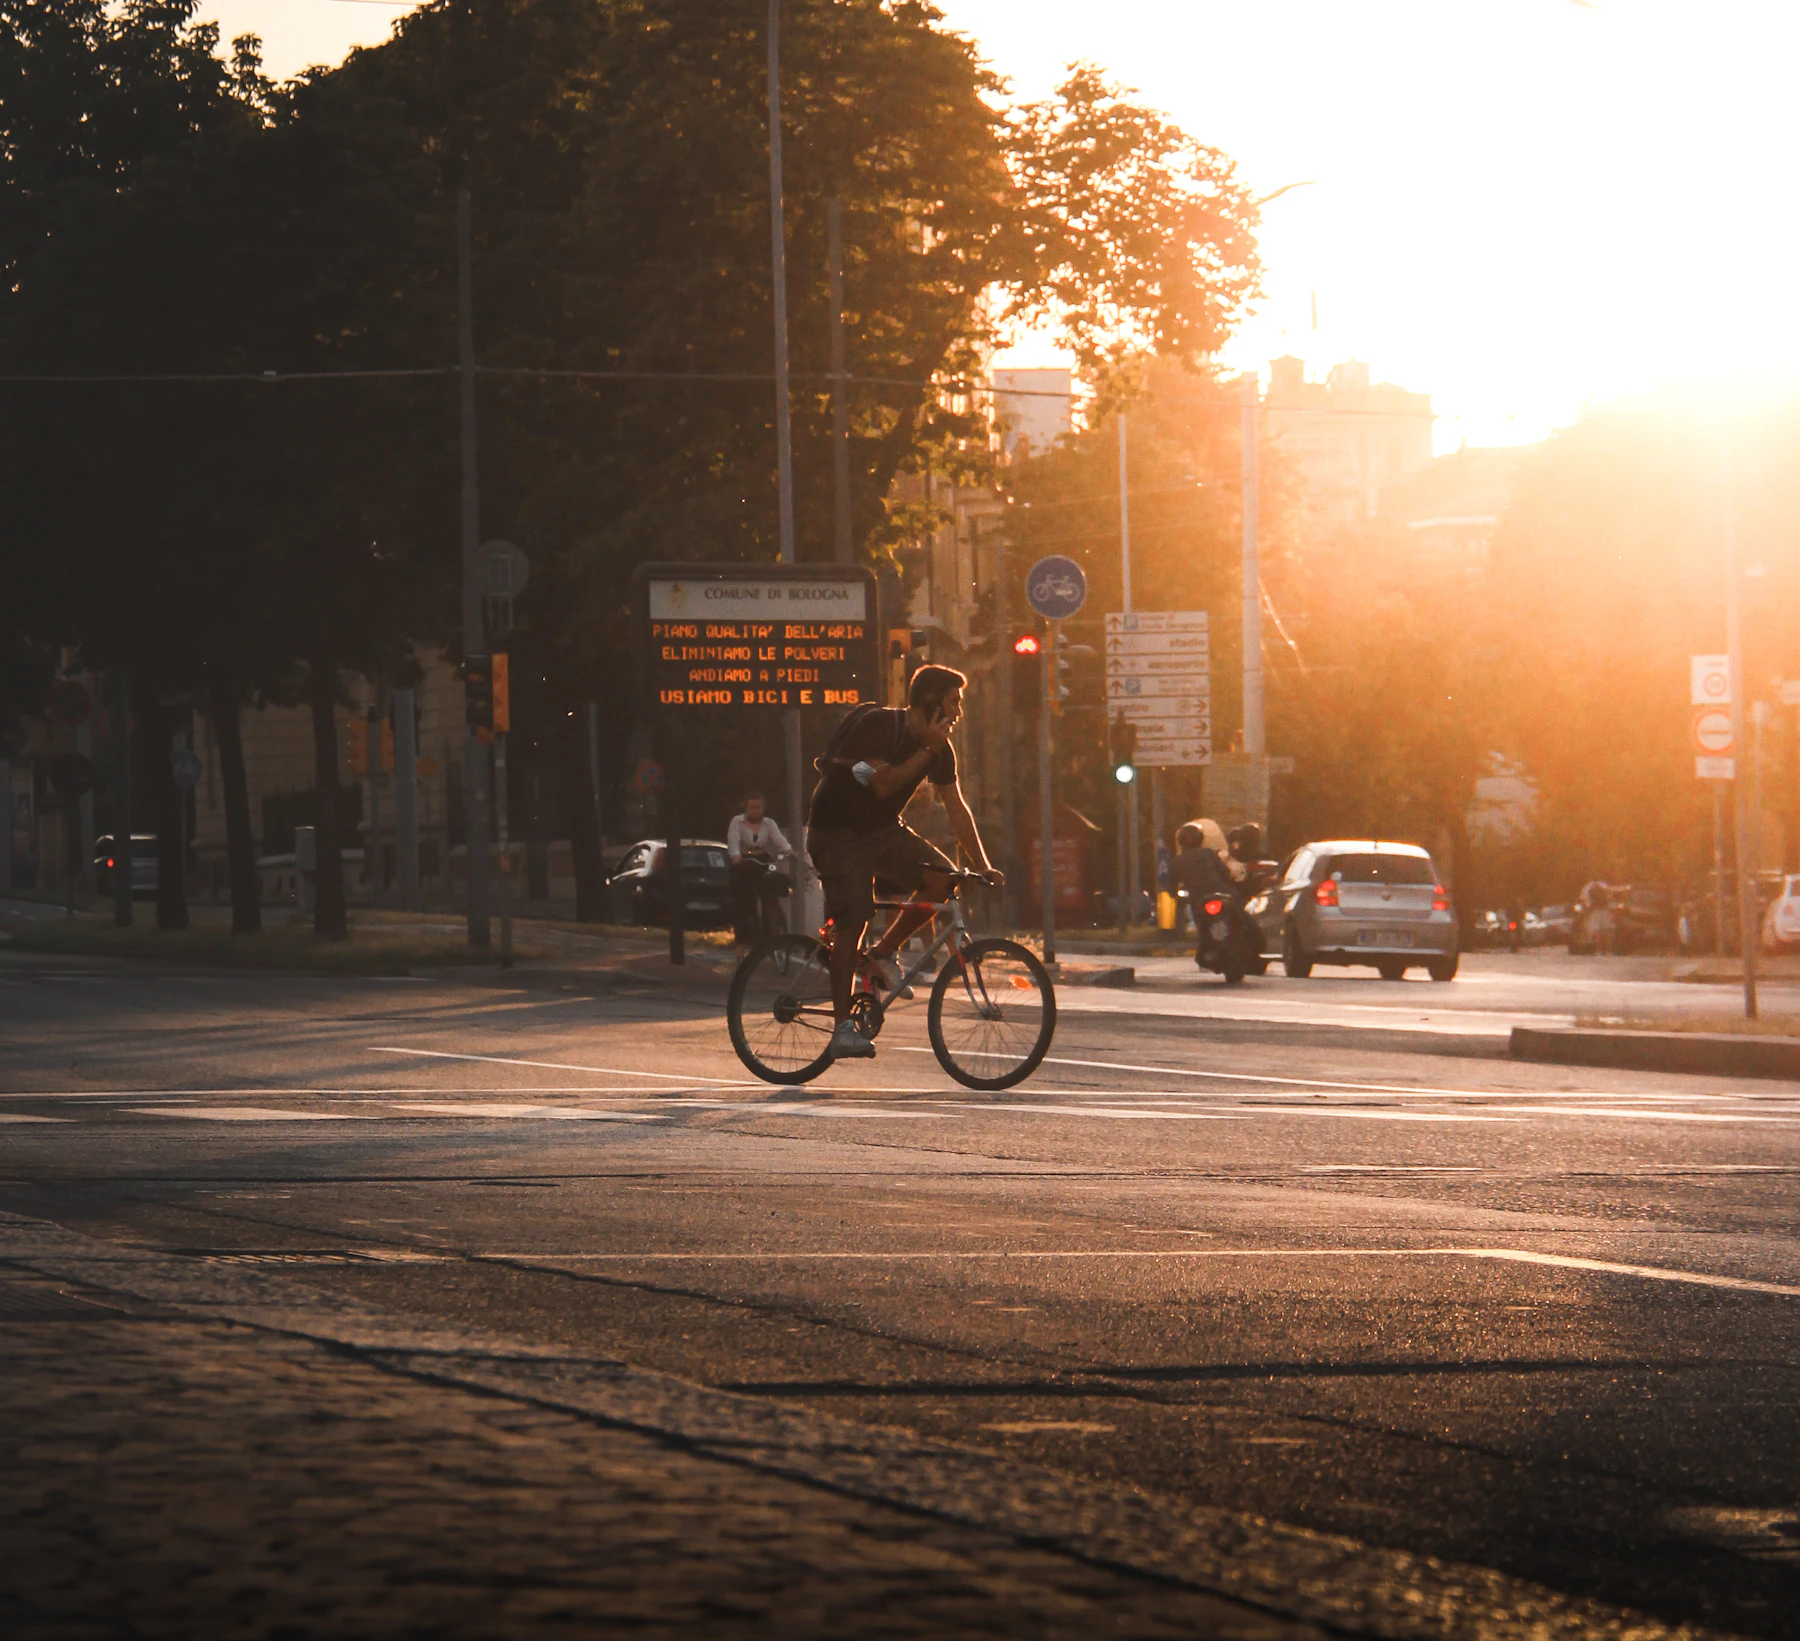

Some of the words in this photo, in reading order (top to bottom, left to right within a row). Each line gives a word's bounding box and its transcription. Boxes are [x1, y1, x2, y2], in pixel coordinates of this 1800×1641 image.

[704, 587, 760, 600] COMUNE
[767, 587, 781, 600] DI
[788, 587, 849, 601] BOLOGNA
[653, 624, 698, 639] PIANO
[705, 624, 773, 639] QUALITA'
[784, 624, 863, 639] DELL'ARIA
[662, 646, 751, 660] ELIMINIAMO
[758, 646, 776, 660] LE
[783, 646, 845, 660] POLVERI
[689, 668, 751, 682] ANDIAMO
[759, 668, 769, 682] A
[776, 668, 819, 682] PIEDI
[660, 690, 732, 704] USIAMO
[742, 690, 788, 704] BICI
[800, 690, 813, 704] E
[823, 690, 859, 704] BUS
